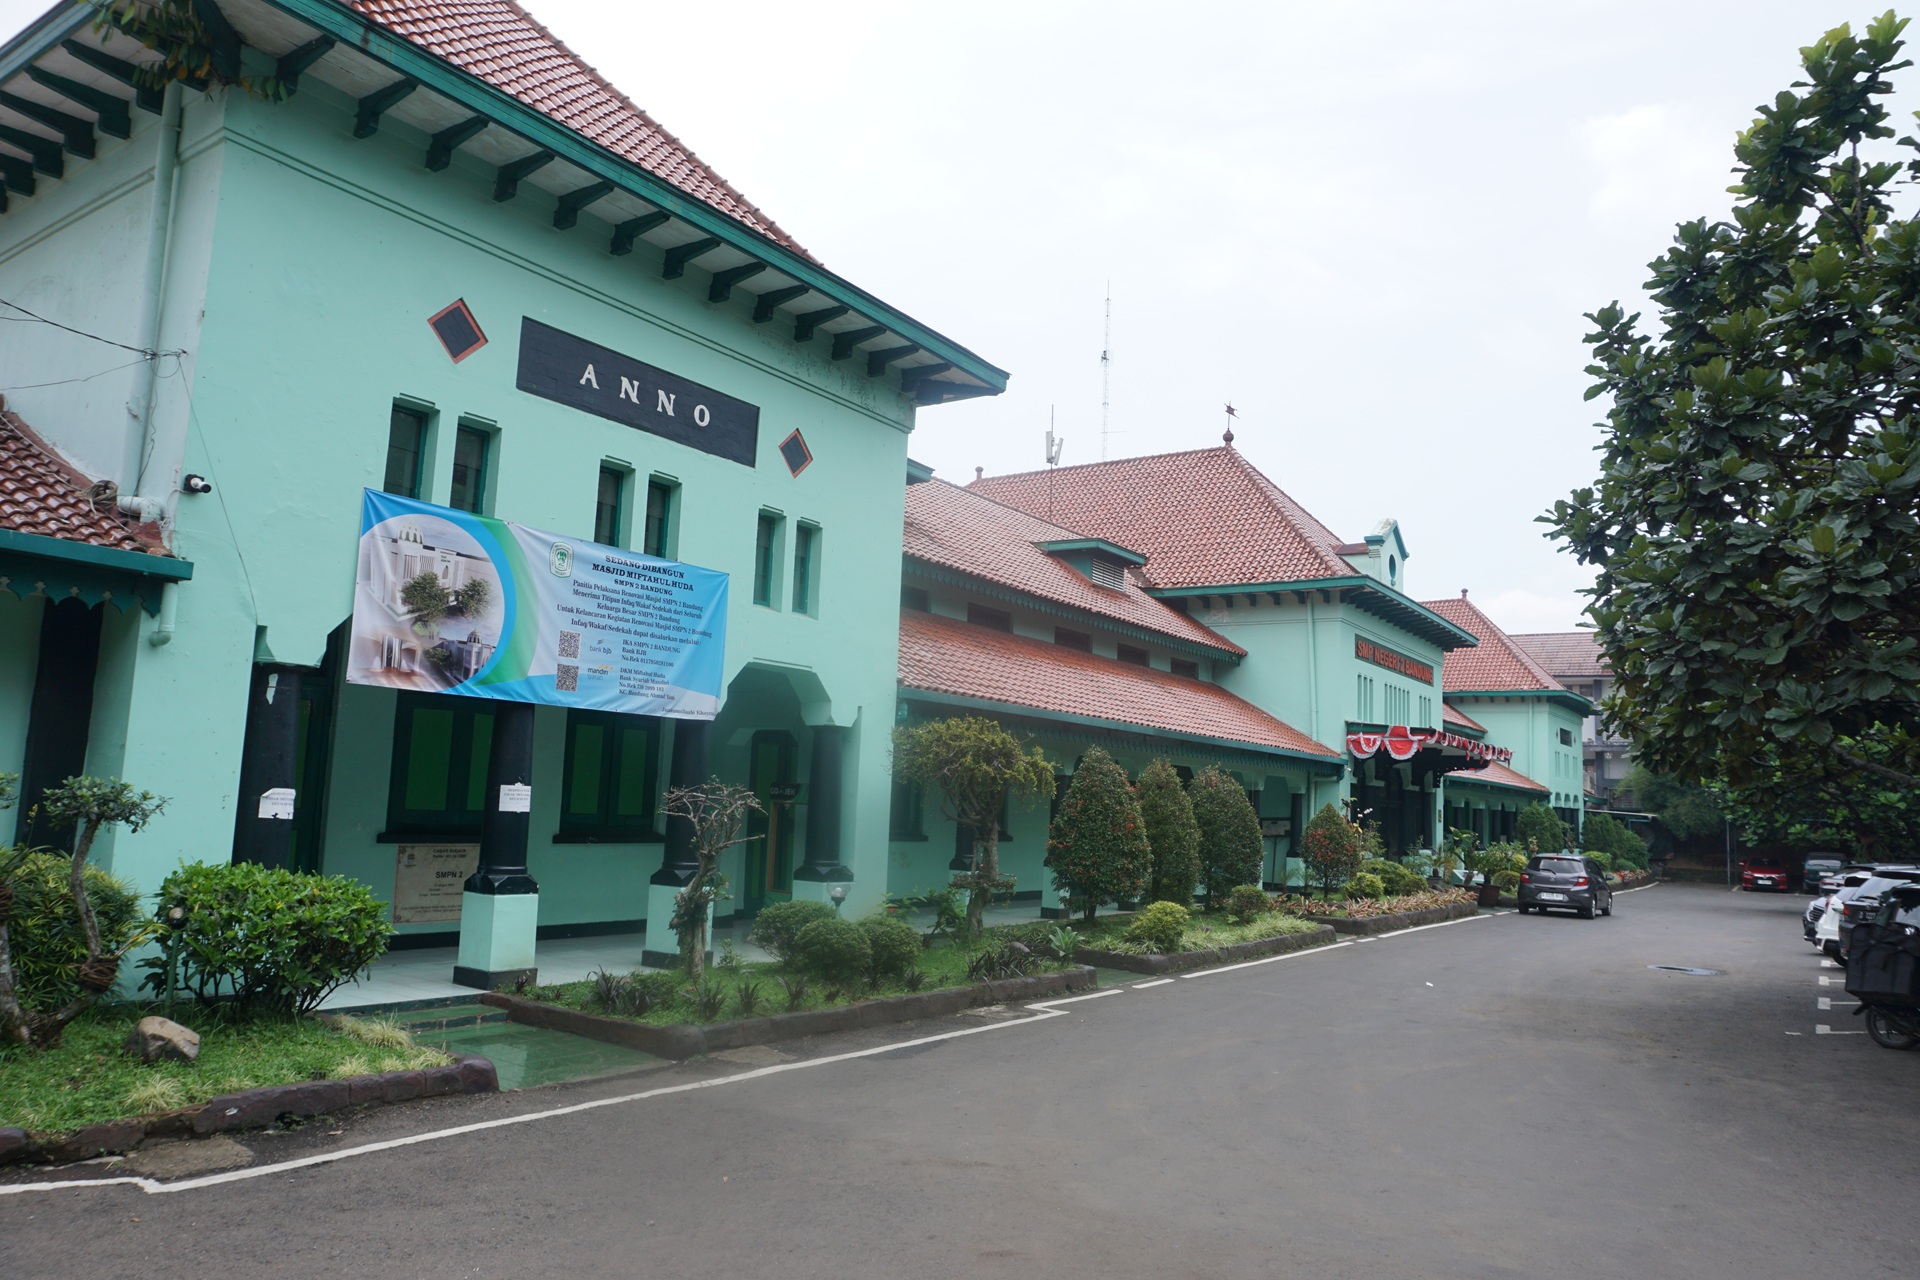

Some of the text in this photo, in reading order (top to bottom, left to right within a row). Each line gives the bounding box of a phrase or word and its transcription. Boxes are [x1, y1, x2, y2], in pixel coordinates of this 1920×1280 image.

[579, 363, 711, 427] ANNO
[592, 563, 694, 592] MASJID MIFTAHUL HUDA
[606, 555, 684, 578] SEDANG DIBANGUN
[573, 580, 592, 589] Panitia
[594, 584, 620, 594] Pelaksana
[622, 589, 644, 599] Renovasi
[646, 594, 661, 604] Masjid
[663, 598, 678, 606] SMPN
[683, 602, 703, 612] Bandung
[614, 579, 634, 588] SMPN
[640, 585, 673, 596] BANDUNG
[573, 589, 600, 600] Menerima
[602, 594, 620, 604] Titipan
[652, 605, 672, 613] Sedekah
[684, 611, 702, 619] Seluruh
[597, 602, 621, 613] Keluarga
[659, 615, 680, 624] Bandung
[557, 604, 574, 613] Untuk
[576, 608, 606, 619] Kelancaran
[607, 613, 630, 623] Kegiatan
[631, 618, 653, 628] Renovasi
[655, 622, 671, 631] Masjid
[672, 625, 687, 633] SMPN
[692, 629, 712, 638] Bandung
[633, 629, 648, 638] dapat
[650, 632, 677, 642] disalurkan
[654, 645, 680, 653] BANDUNG
[1357, 640, 1433, 684] SMP NEGERI 2 BANDUNG
